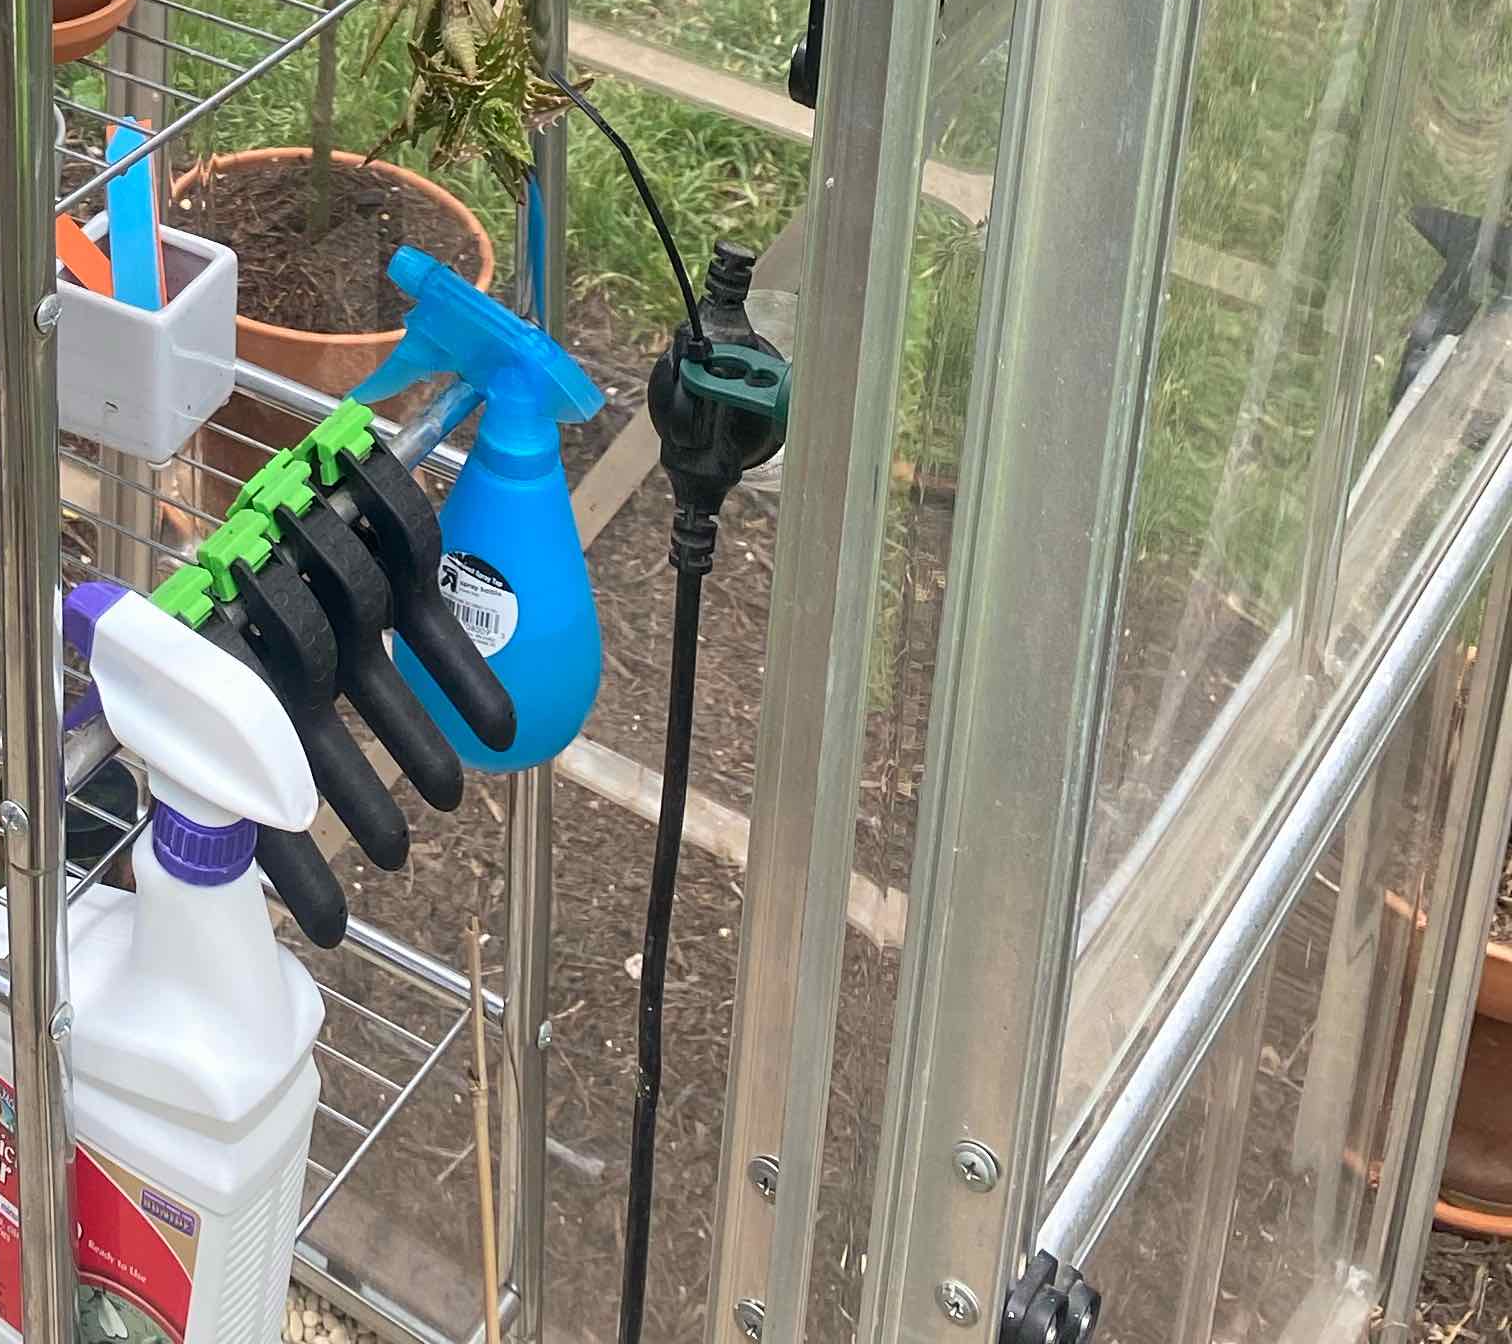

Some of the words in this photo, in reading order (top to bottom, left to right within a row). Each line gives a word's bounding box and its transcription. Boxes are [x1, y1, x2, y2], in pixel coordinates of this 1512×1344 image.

[88, 1239, 114, 1263] Ready
[117, 1260, 128, 1271] to
[129, 1264, 148, 1283] Use
